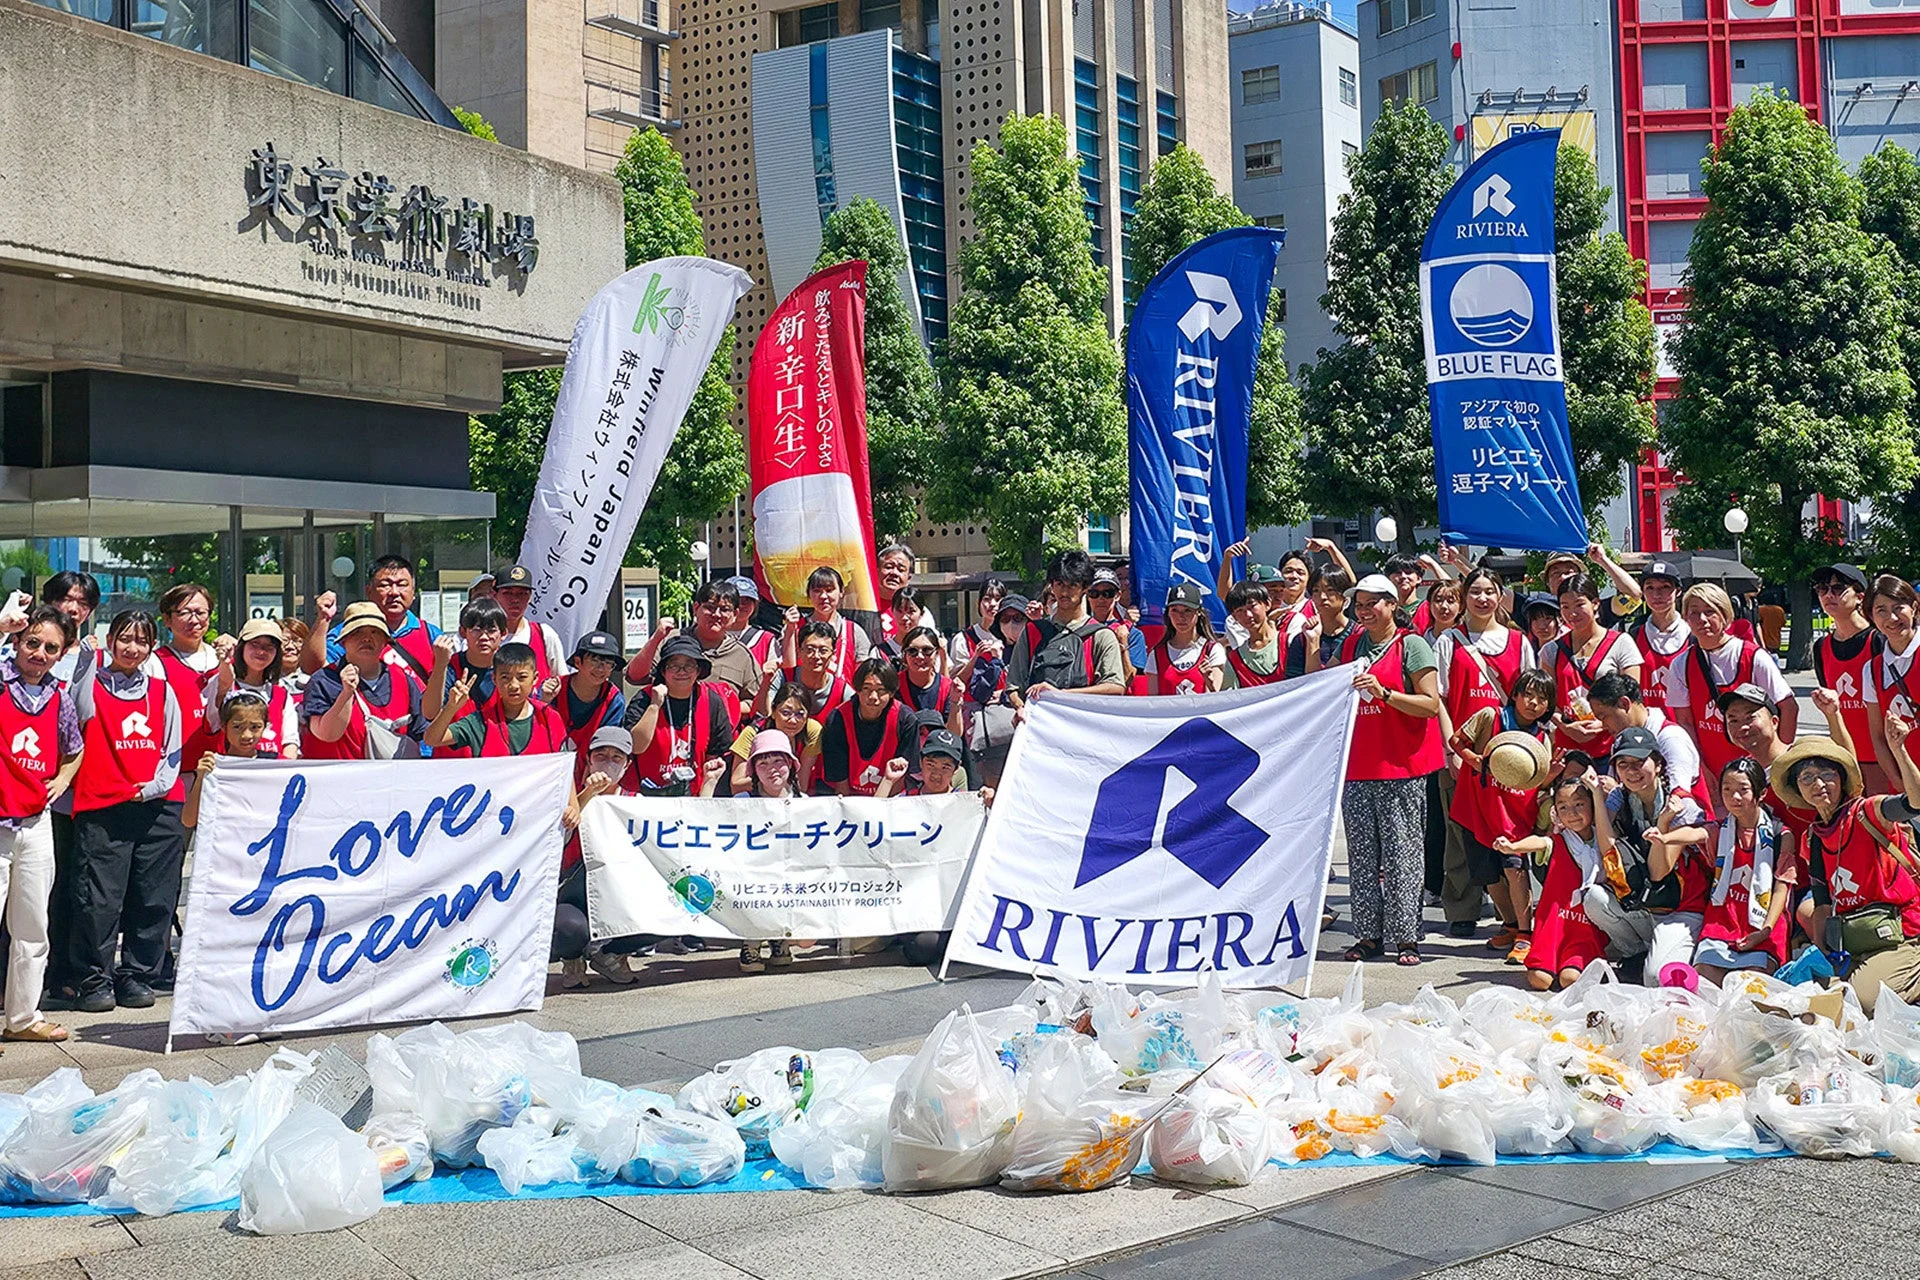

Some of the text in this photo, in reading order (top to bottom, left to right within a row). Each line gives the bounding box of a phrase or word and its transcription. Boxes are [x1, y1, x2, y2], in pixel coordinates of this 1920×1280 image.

[1456, 222, 1529, 239] RIVIERA
[1438, 355, 1557, 377] BLUE FLAG
[813, 288, 834, 468] 飲みごたえとキレのよさ
[1460, 399, 1540, 414] アジアで初の
[619, 366, 665, 479] Winfield
[1463, 415, 1540, 430] 認証マリーナ
[1472, 446, 1543, 468] リビエラ
[1167, 347, 1219, 604] RIVIERA
[1452, 472, 1567, 494] 逗子マリーナ
[580, 481, 624, 566] Japan
[1470, 688, 1499, 700] RIVIE
[229, 773, 514, 916] Love,
[626, 817, 943, 852] リビエラビーチクリーン
[732, 880, 903, 895] リビエラ未来づくりプロジェクト
[732, 897, 902, 909] RIVIERA SUSTAINABILITY PROJECTS
[1558, 908, 1589, 925] RIVIE
[251, 868, 521, 1012] Ocean
[977, 893, 1308, 974] RIVIERA
